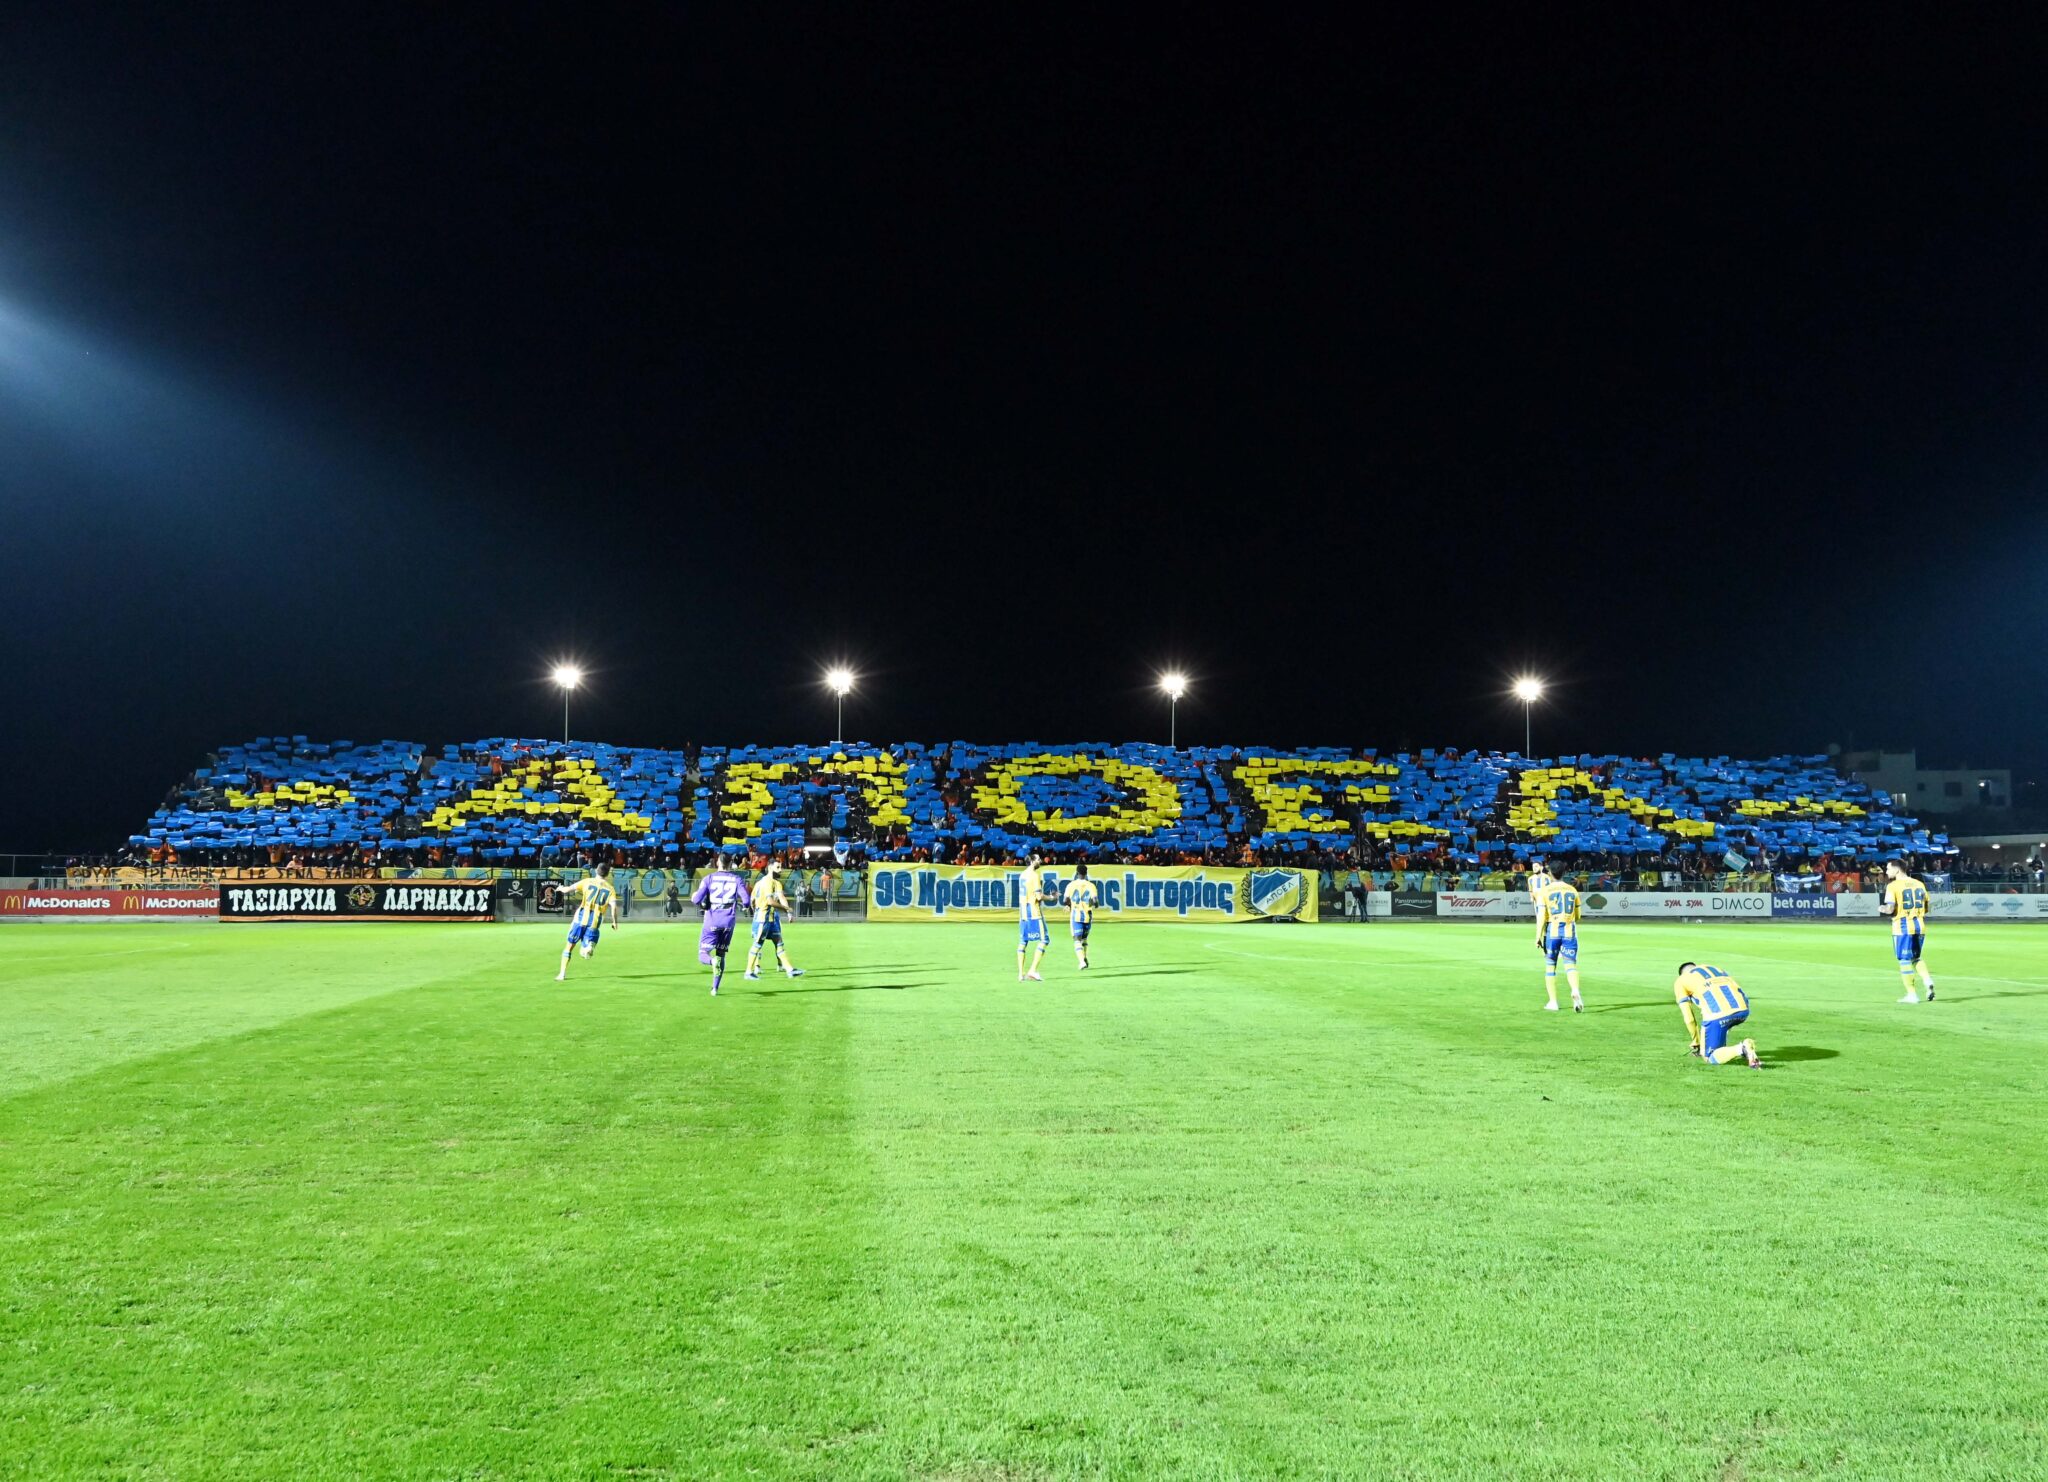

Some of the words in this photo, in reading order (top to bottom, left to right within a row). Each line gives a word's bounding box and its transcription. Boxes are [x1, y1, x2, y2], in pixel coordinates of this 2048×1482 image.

[27, 897, 111, 908] McDonald's
[228, 888, 336, 912] ΤΑΞΙΑΡΧΙΑ
[383, 888, 490, 912] ΛΑΡΝΑΚΑΣ
[587, 885, 610, 906] 70
[710, 882, 737, 904] 22
[875, 871, 912, 906] 96
[1125, 873, 1233, 914] Ιστορίας
[1071, 889, 1091, 904] 44
[1773, 897, 1794, 908] bet
[1796, 899, 1811, 908] on
[1812, 897, 1835, 908] alfa
[1548, 892, 1576, 915] 36
[1712, 898, 1764, 910] DIMCO
